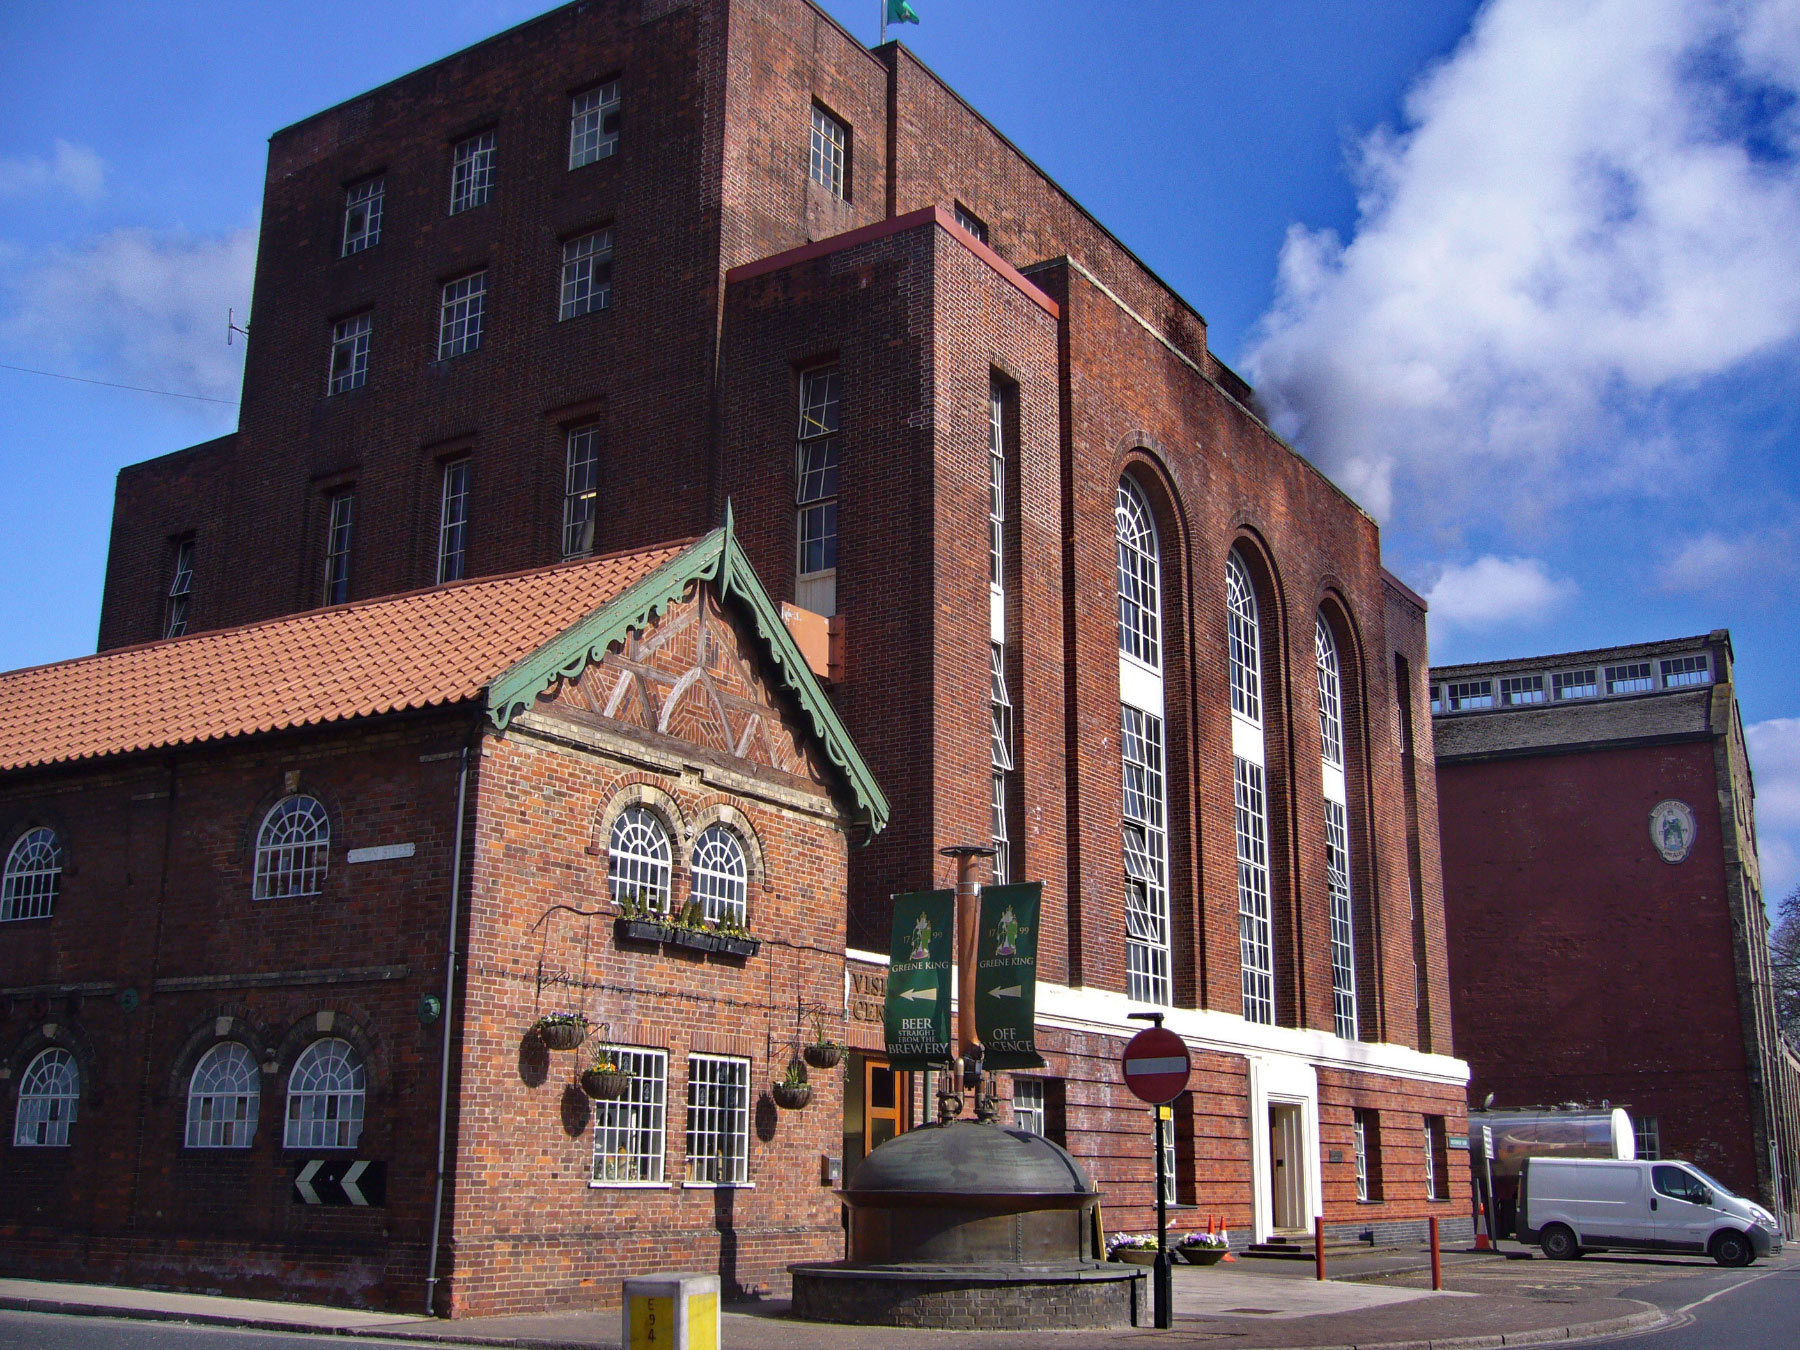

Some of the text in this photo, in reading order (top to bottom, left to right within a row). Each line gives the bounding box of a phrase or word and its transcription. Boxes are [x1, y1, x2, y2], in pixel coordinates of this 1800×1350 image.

[903, 931, 943, 944] 17 99
[989, 926, 1030, 937] 17 99
[892, 961, 949, 973] GREENE KING
[979, 957, 1034, 968] GREENE KING
[852, 973, 888, 997] VISI
[853, 1000, 885, 1024] CEN
[902, 1017, 933, 1030] BEER
[898, 1029, 936, 1037] STRAIGHT
[993, 1027, 1017, 1041] OFF
[888, 1042, 949, 1054] BREWERY
